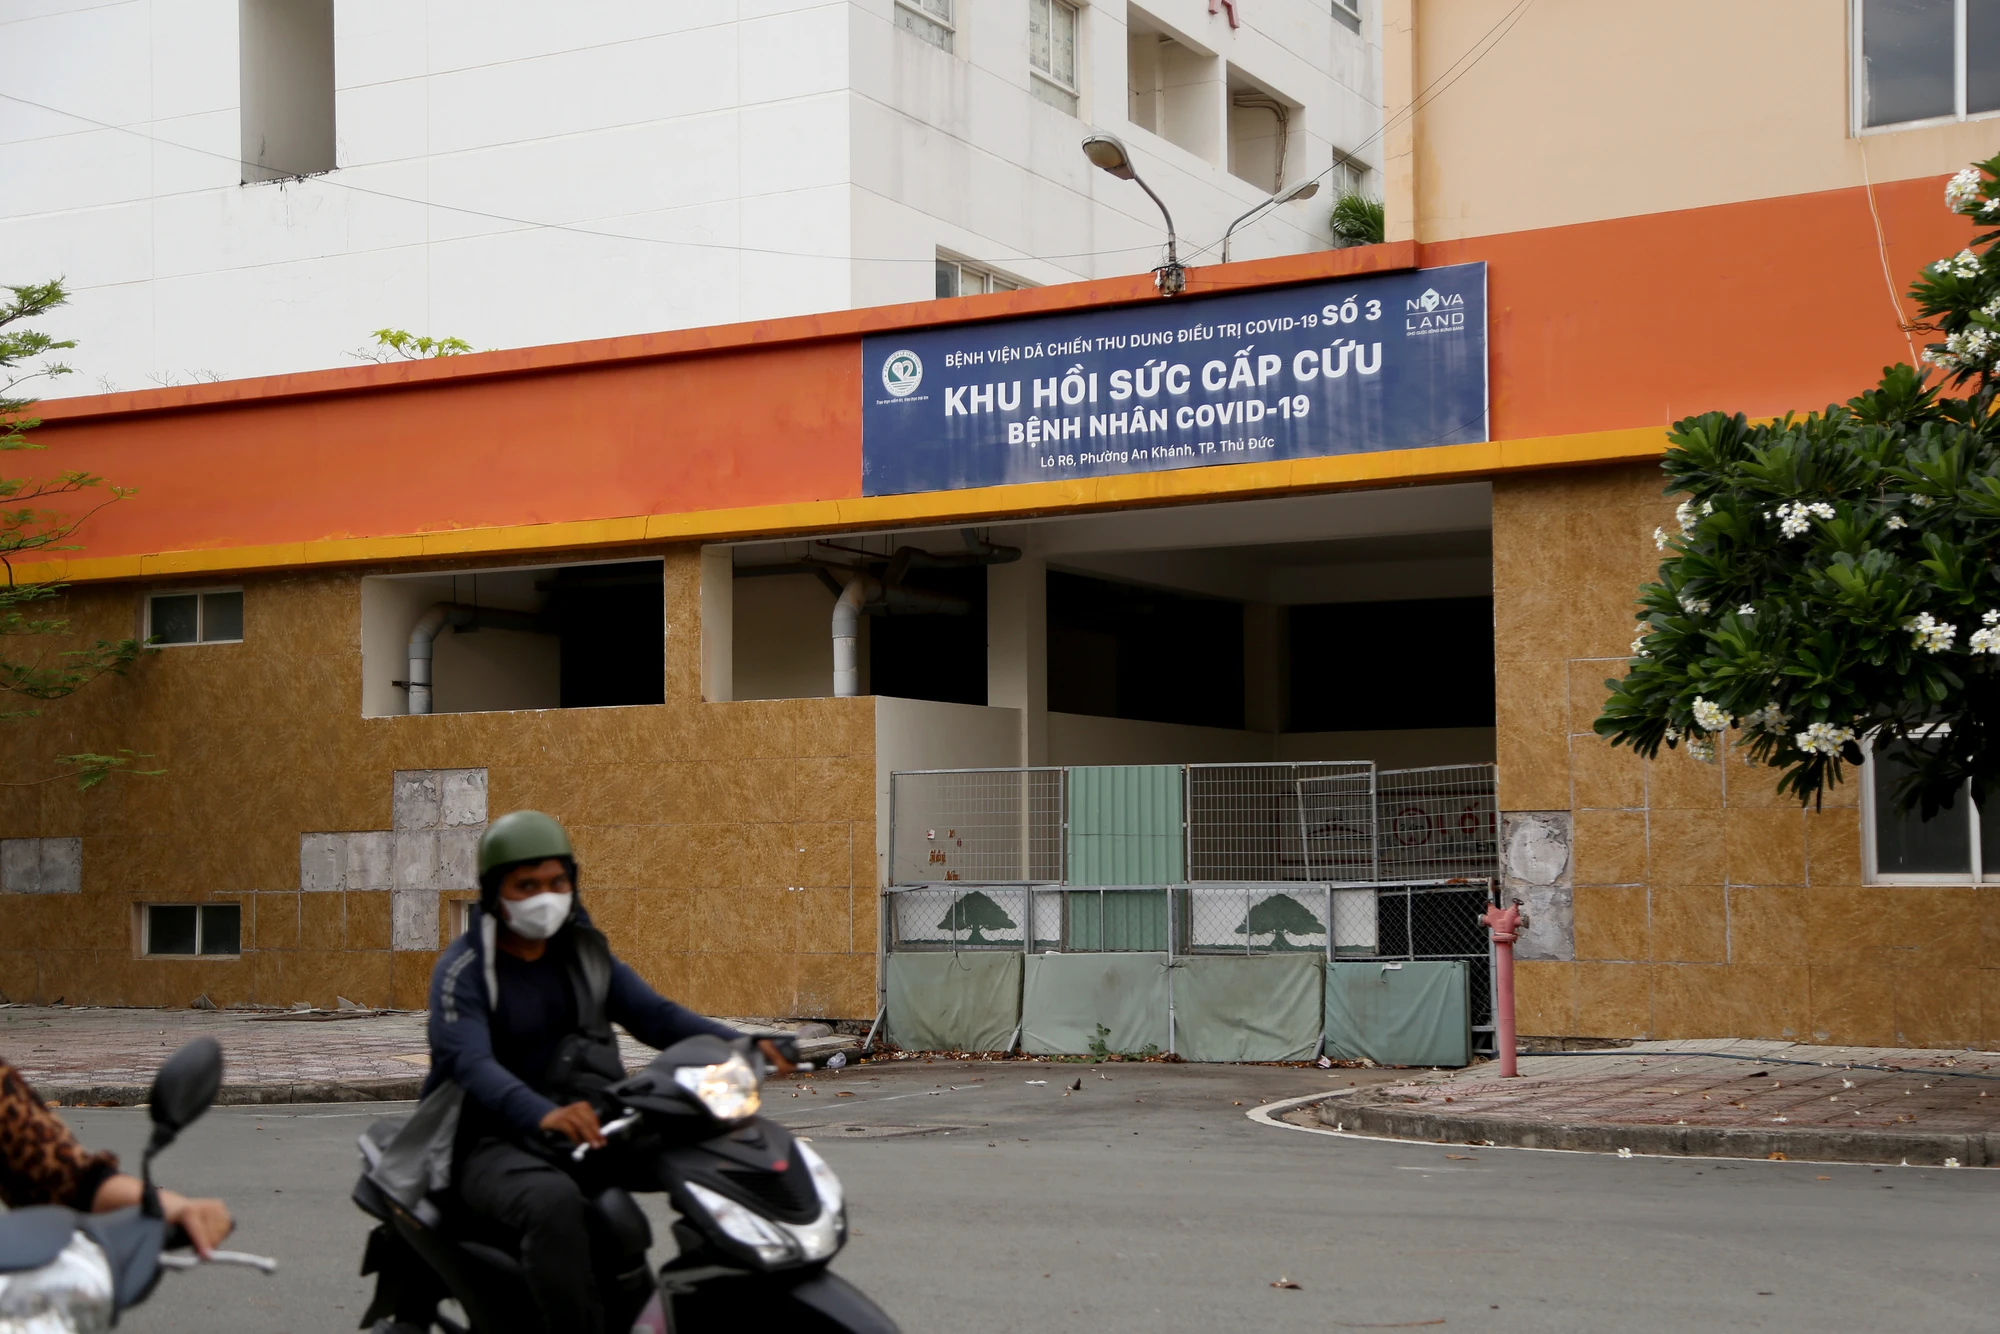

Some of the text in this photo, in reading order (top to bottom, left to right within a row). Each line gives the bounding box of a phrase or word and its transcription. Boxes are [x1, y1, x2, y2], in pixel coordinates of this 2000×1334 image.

[945, 294, 1382, 369] BỆNH VIỆN DÃ CHIẾN THU DUNG ĐIỀU TRỊ COVID-19 SỐ 3
[1406, 313, 1464, 330] LAND
[944, 380, 1021, 417] KHU
[1033, 363, 1098, 408] HỒI
[1109, 358, 1191, 401] SỨC
[1201, 345, 1282, 391] CẤP
[1292, 338, 1382, 382] CỨU
[1008, 394, 1310, 448] BỆNH NHÂN COVID-19
[1040, 436, 1275, 468] Lô R6, Phường An Khánh, TP. Thủ Đức
